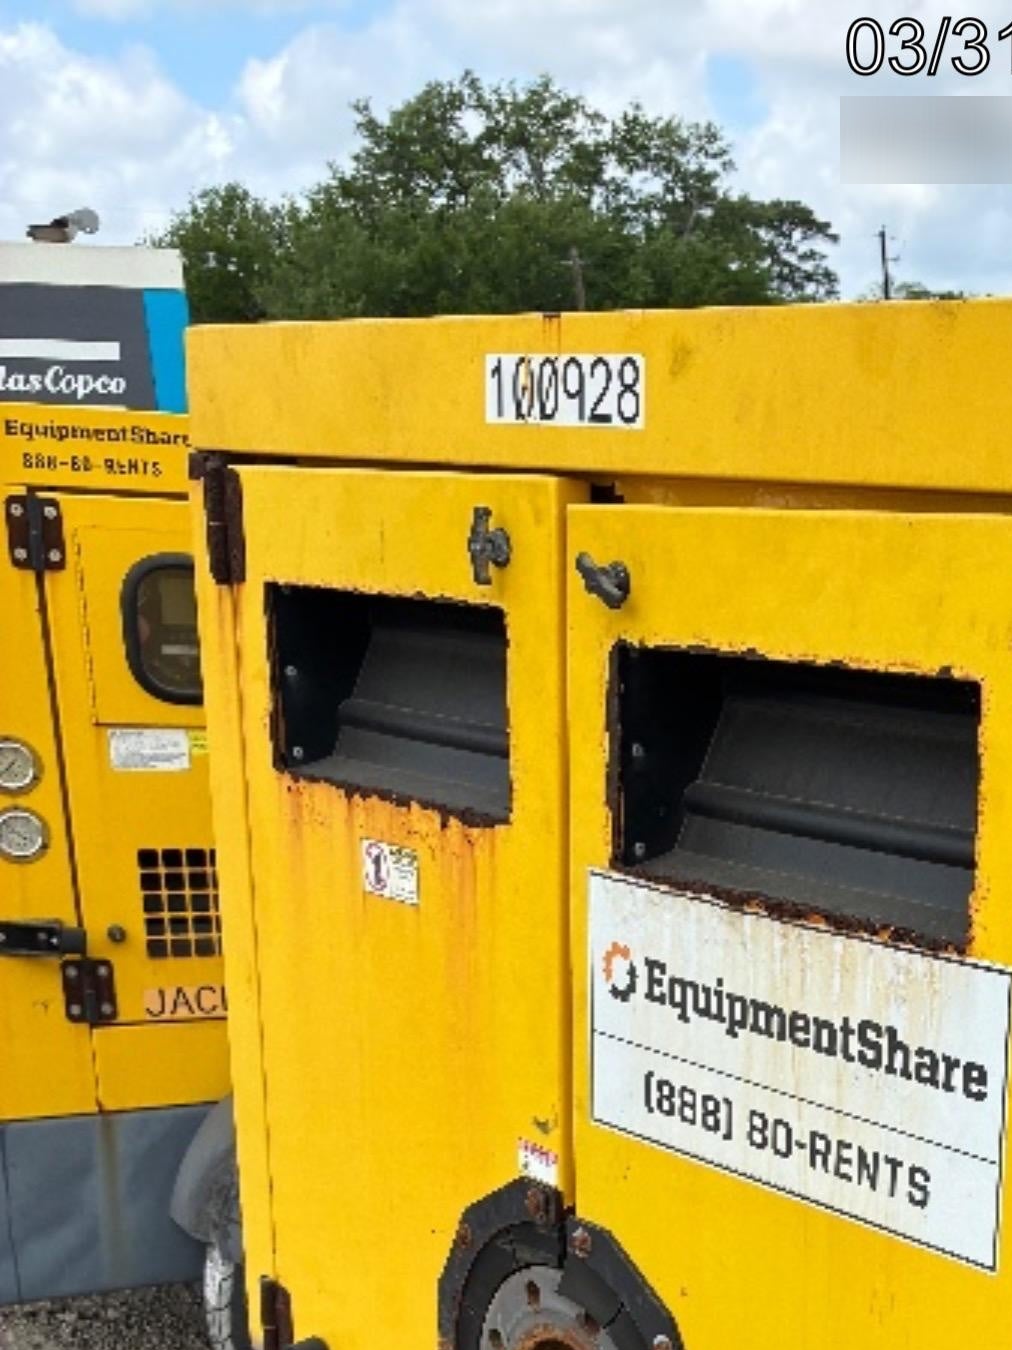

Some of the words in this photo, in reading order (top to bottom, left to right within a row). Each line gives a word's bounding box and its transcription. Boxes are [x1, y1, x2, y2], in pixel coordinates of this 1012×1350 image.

[44, 365, 127, 400] Copco
[490, 356, 640, 424] 100928
[643, 957, 989, 1102] EquipmentShare
[643, 1070, 734, 1141] (888)
[746, 1109, 932, 1210] 80-RENTS
